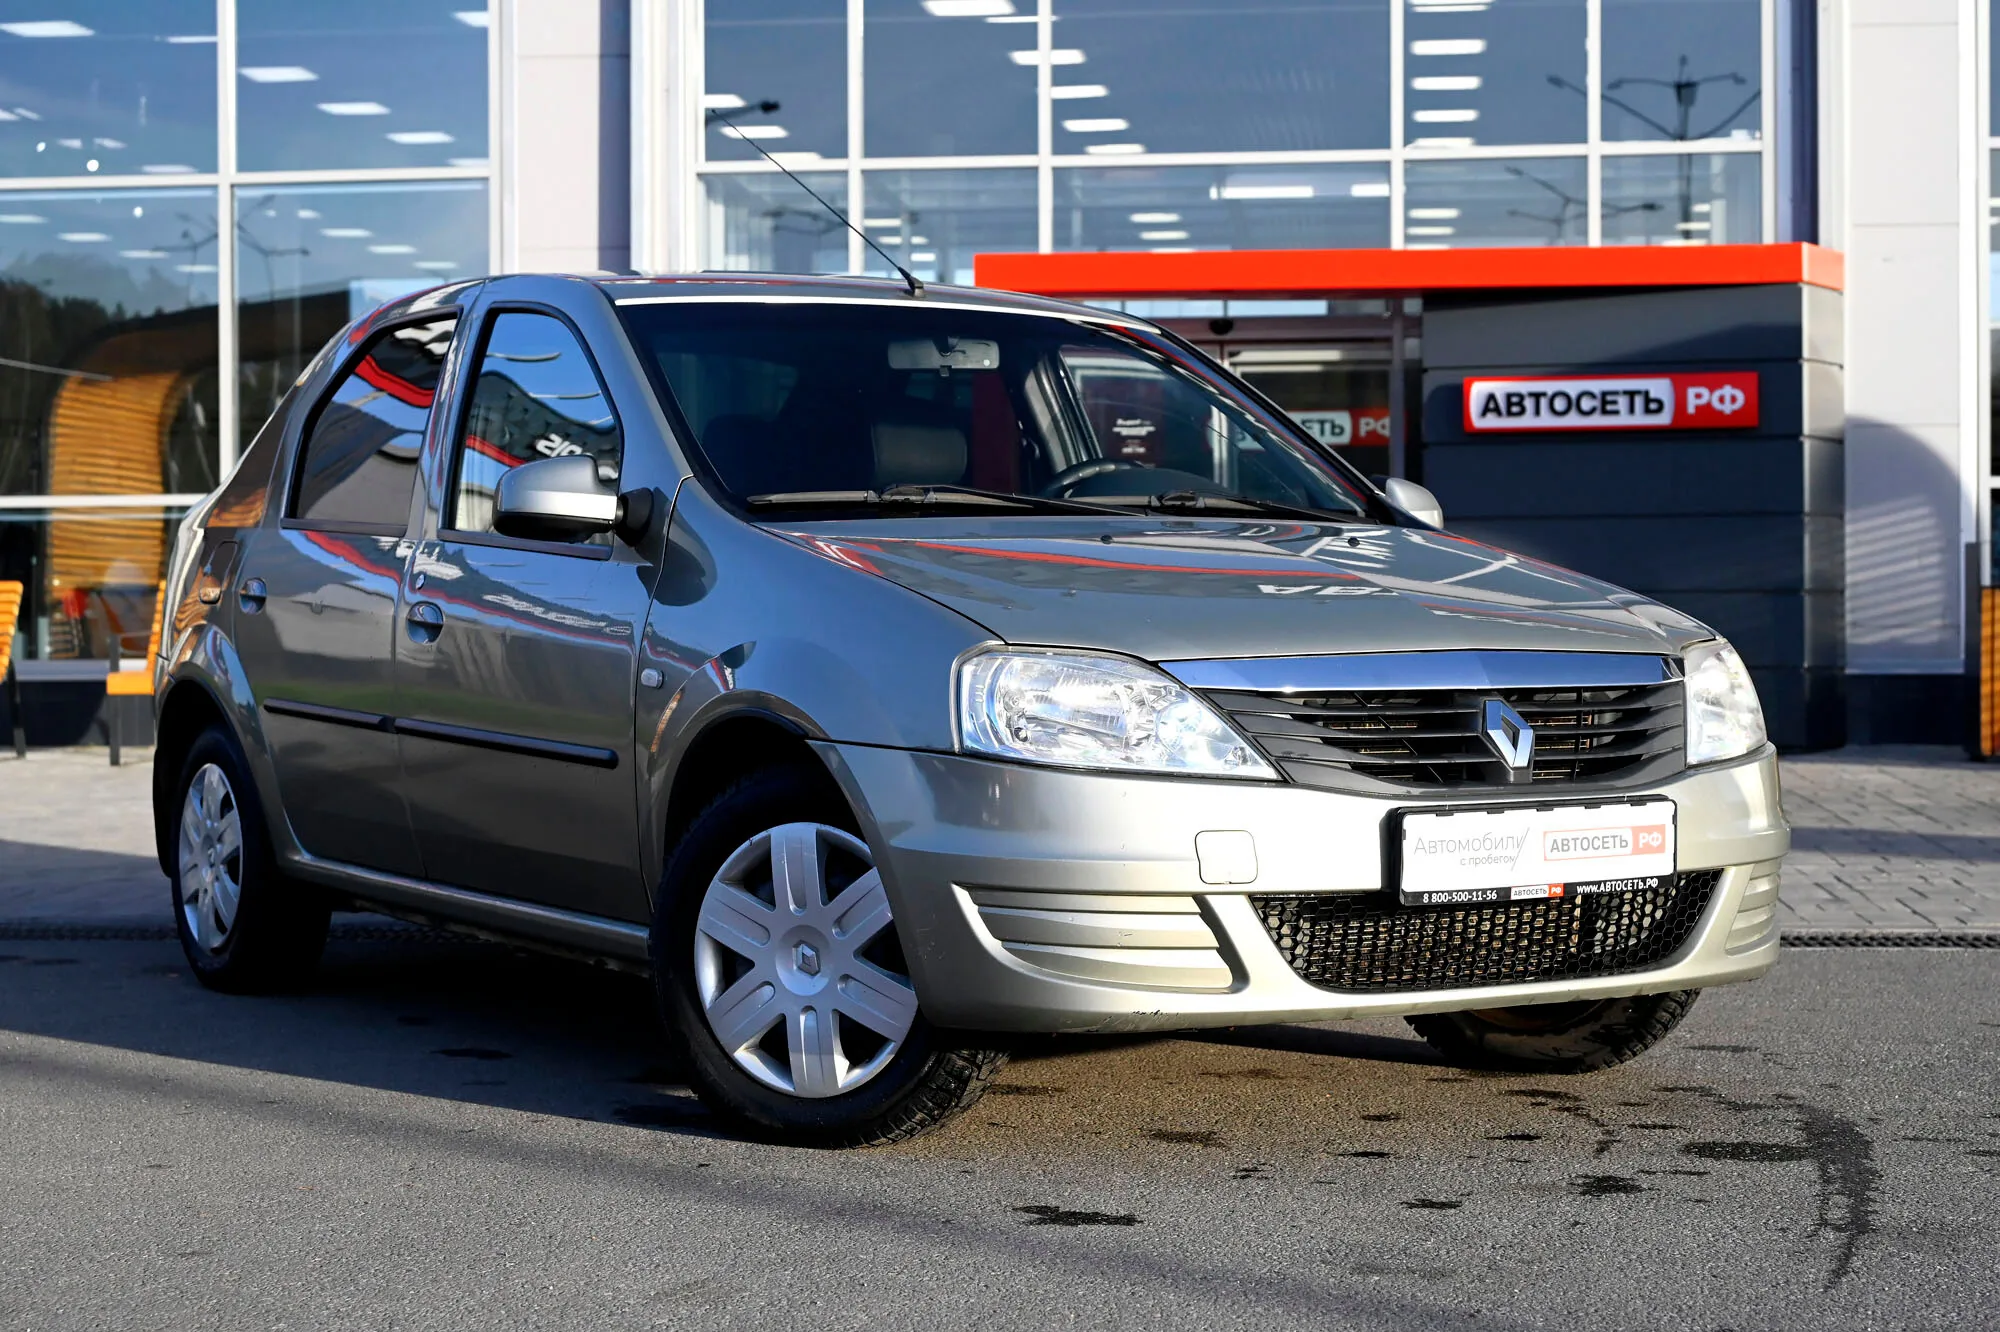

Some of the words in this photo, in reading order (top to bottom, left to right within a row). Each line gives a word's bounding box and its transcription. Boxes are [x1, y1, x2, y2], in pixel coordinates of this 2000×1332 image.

[1480, 389, 1665, 418] АВТОСЕТЬ
[1686, 384, 1746, 415] РФ
[1414, 831, 1524, 855] Автомобили
[1550, 834, 1629, 853] АВТОСЕТЬ
[1638, 831, 1662, 848] РФ
[1460, 857, 1467, 866] с
[1468, 853, 1517, 868] пробегом
[1513, 887, 1548, 897] АВТОСЕТЬ
[1550, 886, 1562, 895] РФ
[1576, 877, 1659, 895] www.АВТОСЕТЬ.РФ
[1422, 893, 1429, 903] 8
[1431, 890, 1498, 903] 800-500-11-56
